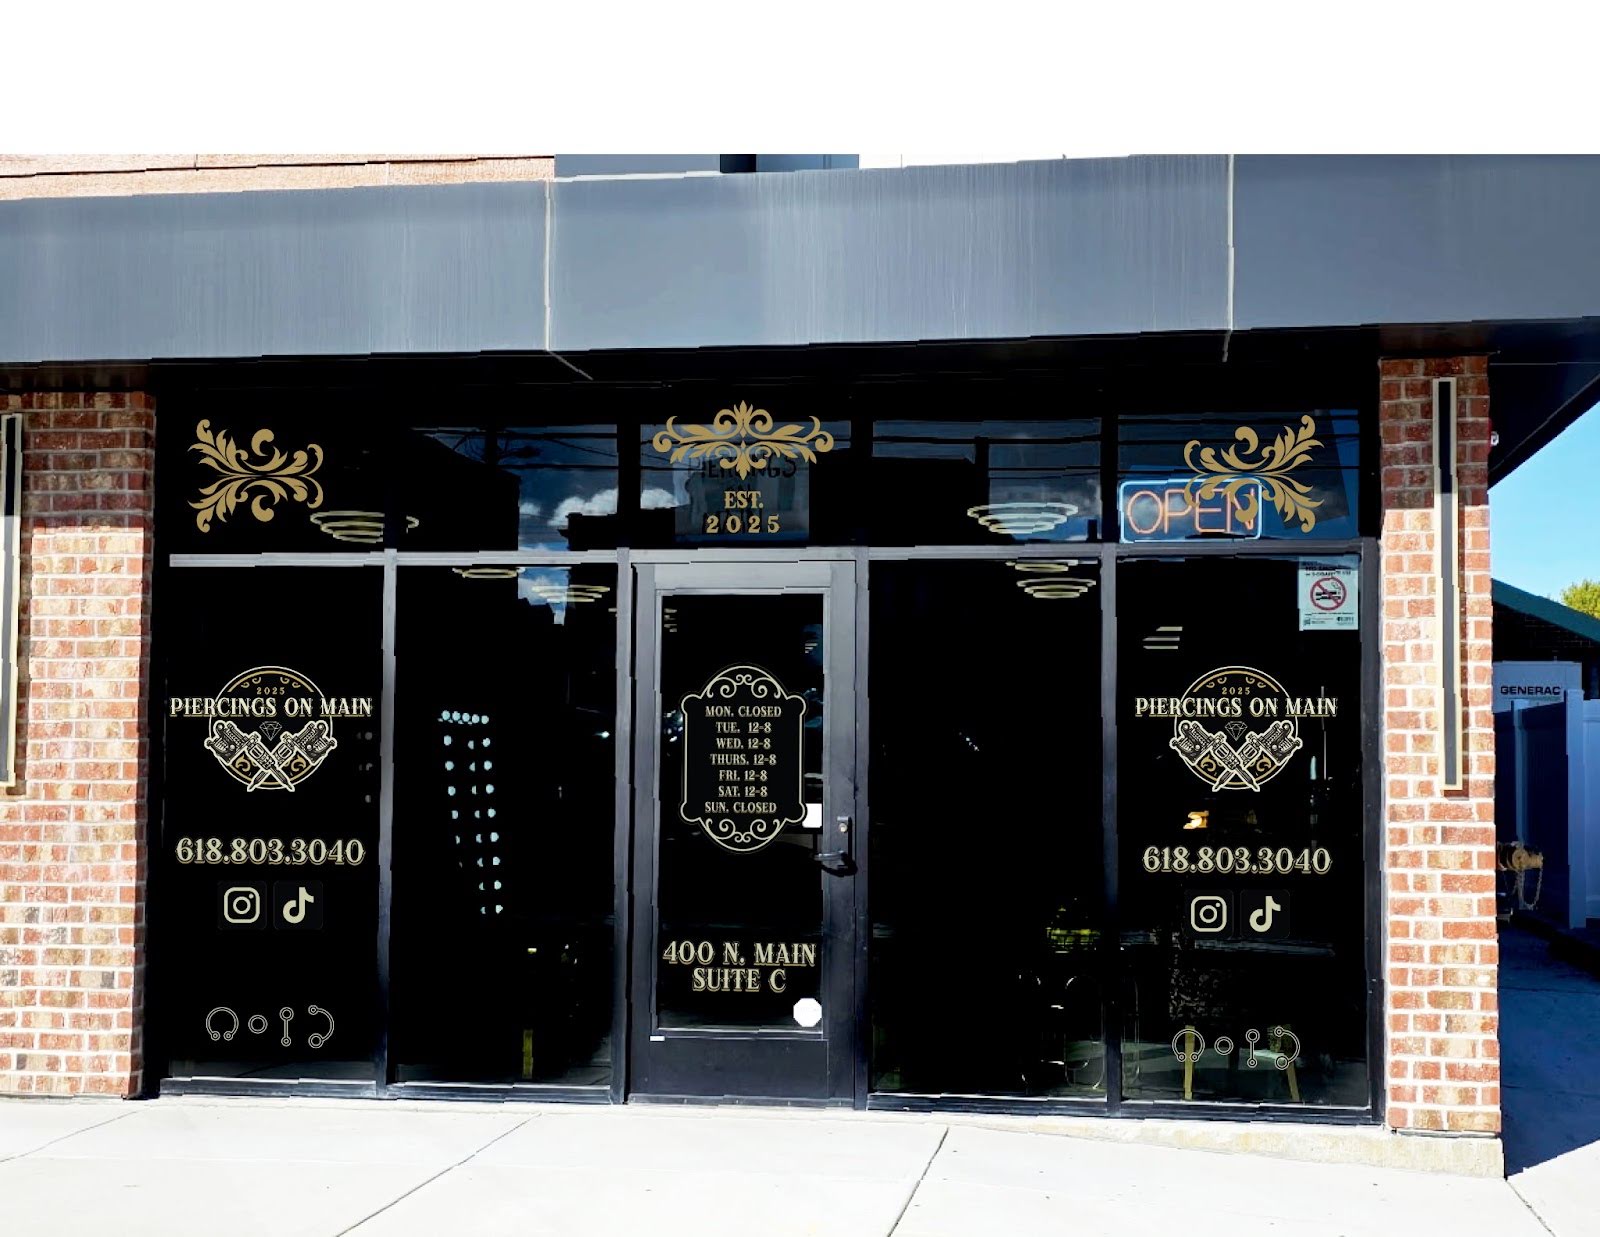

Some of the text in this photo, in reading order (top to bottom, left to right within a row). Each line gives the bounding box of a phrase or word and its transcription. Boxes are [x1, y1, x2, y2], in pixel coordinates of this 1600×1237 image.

[724, 491, 764, 509] EST.
[1127, 487, 1255, 535] OPEN
[706, 515, 781, 534] 2025
[256, 686, 286, 695] 2025
[1221, 686, 1251, 695] 2025
[1500, 685, 1561, 696] GENERAC
[169, 697, 373, 717] PIERCINGS ON MAIN
[705, 706, 782, 717] MON. CLOSED
[1135, 697, 1338, 717] PIERCINGS ON MAIN
[715, 722, 772, 733] TUE. 12-8
[716, 738, 771, 749] WED. 12-8
[710, 754, 777, 765] THURS. 12-8
[719, 770, 768, 781] FRI. 12-8
[718, 786, 768, 797] SAT. 12-8
[704, 802, 777, 813] SUN. CLOSED
[175, 837, 366, 865] 618.803.3040
[1142, 846, 1333, 874] 618.803.3040
[662, 940, 817, 967] 400 N. MAIN
[692, 967, 787, 993] SUITE C
